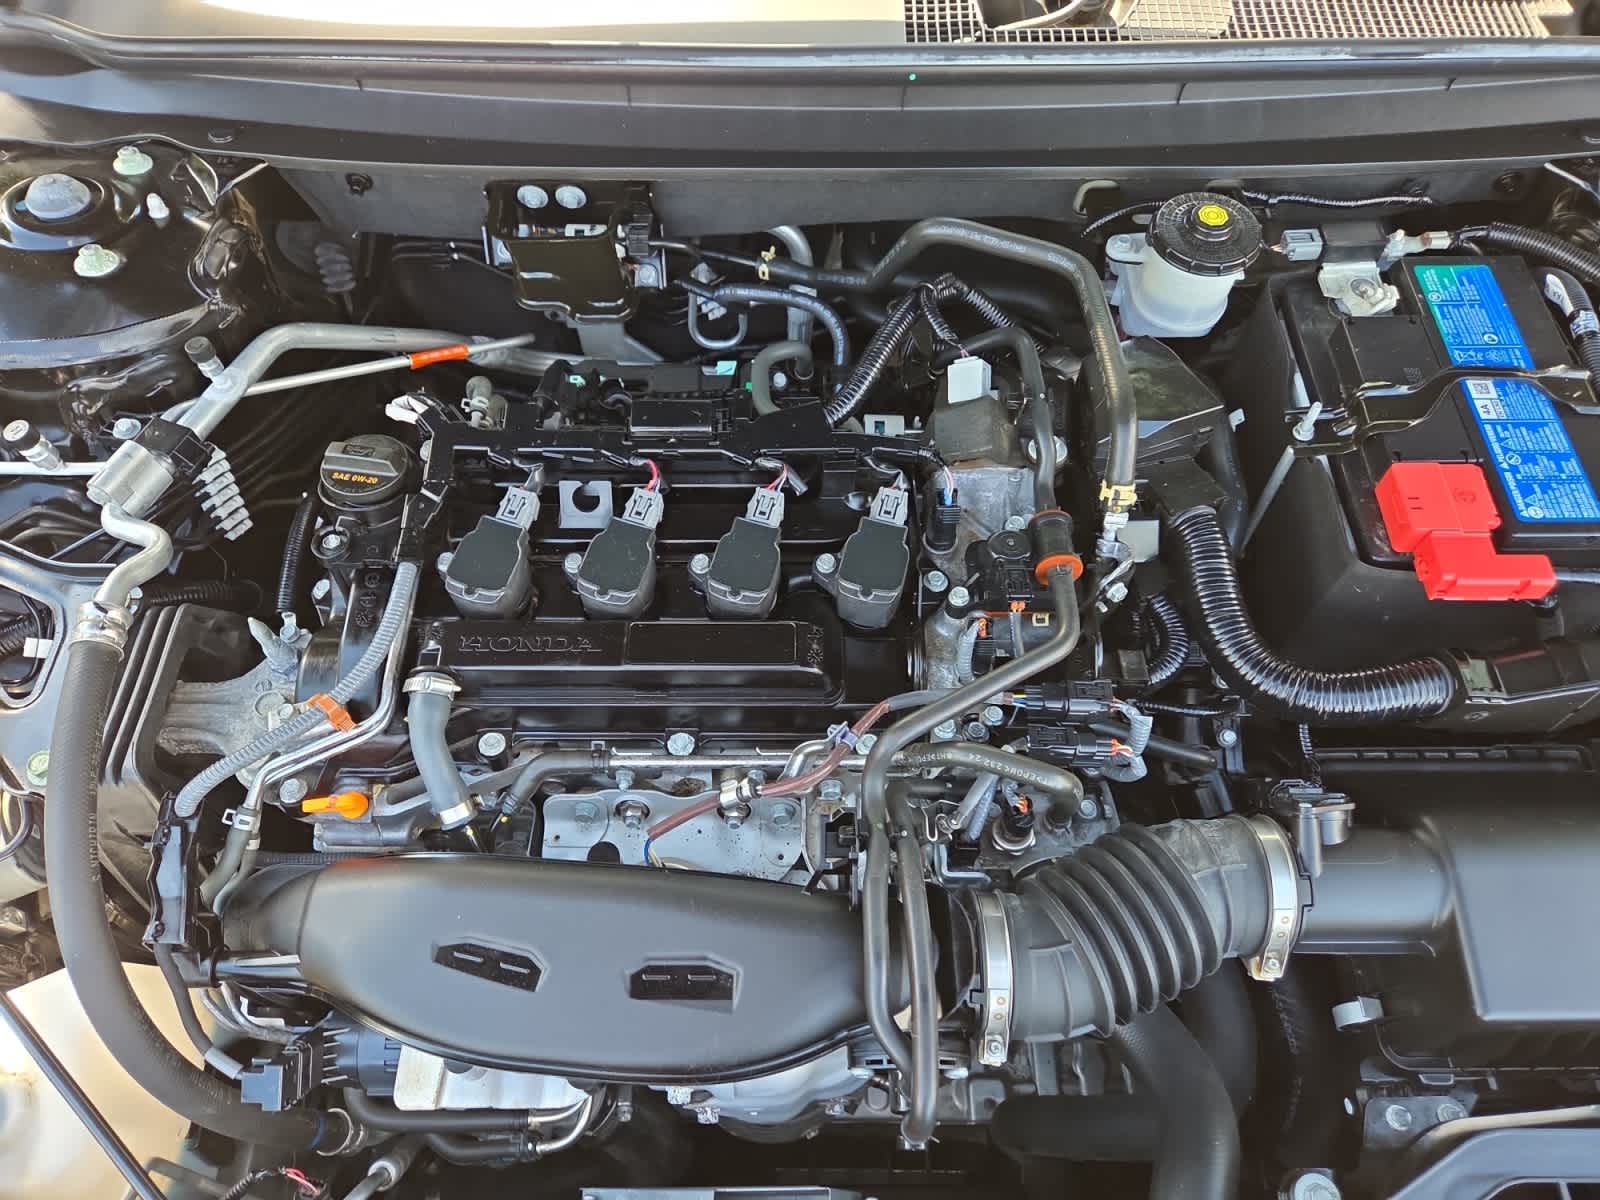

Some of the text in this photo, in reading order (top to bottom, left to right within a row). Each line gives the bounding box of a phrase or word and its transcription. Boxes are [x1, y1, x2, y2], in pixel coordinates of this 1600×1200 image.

[331, 471, 379, 485] SAE 0W-20
[458, 635, 603, 652] HONDA
